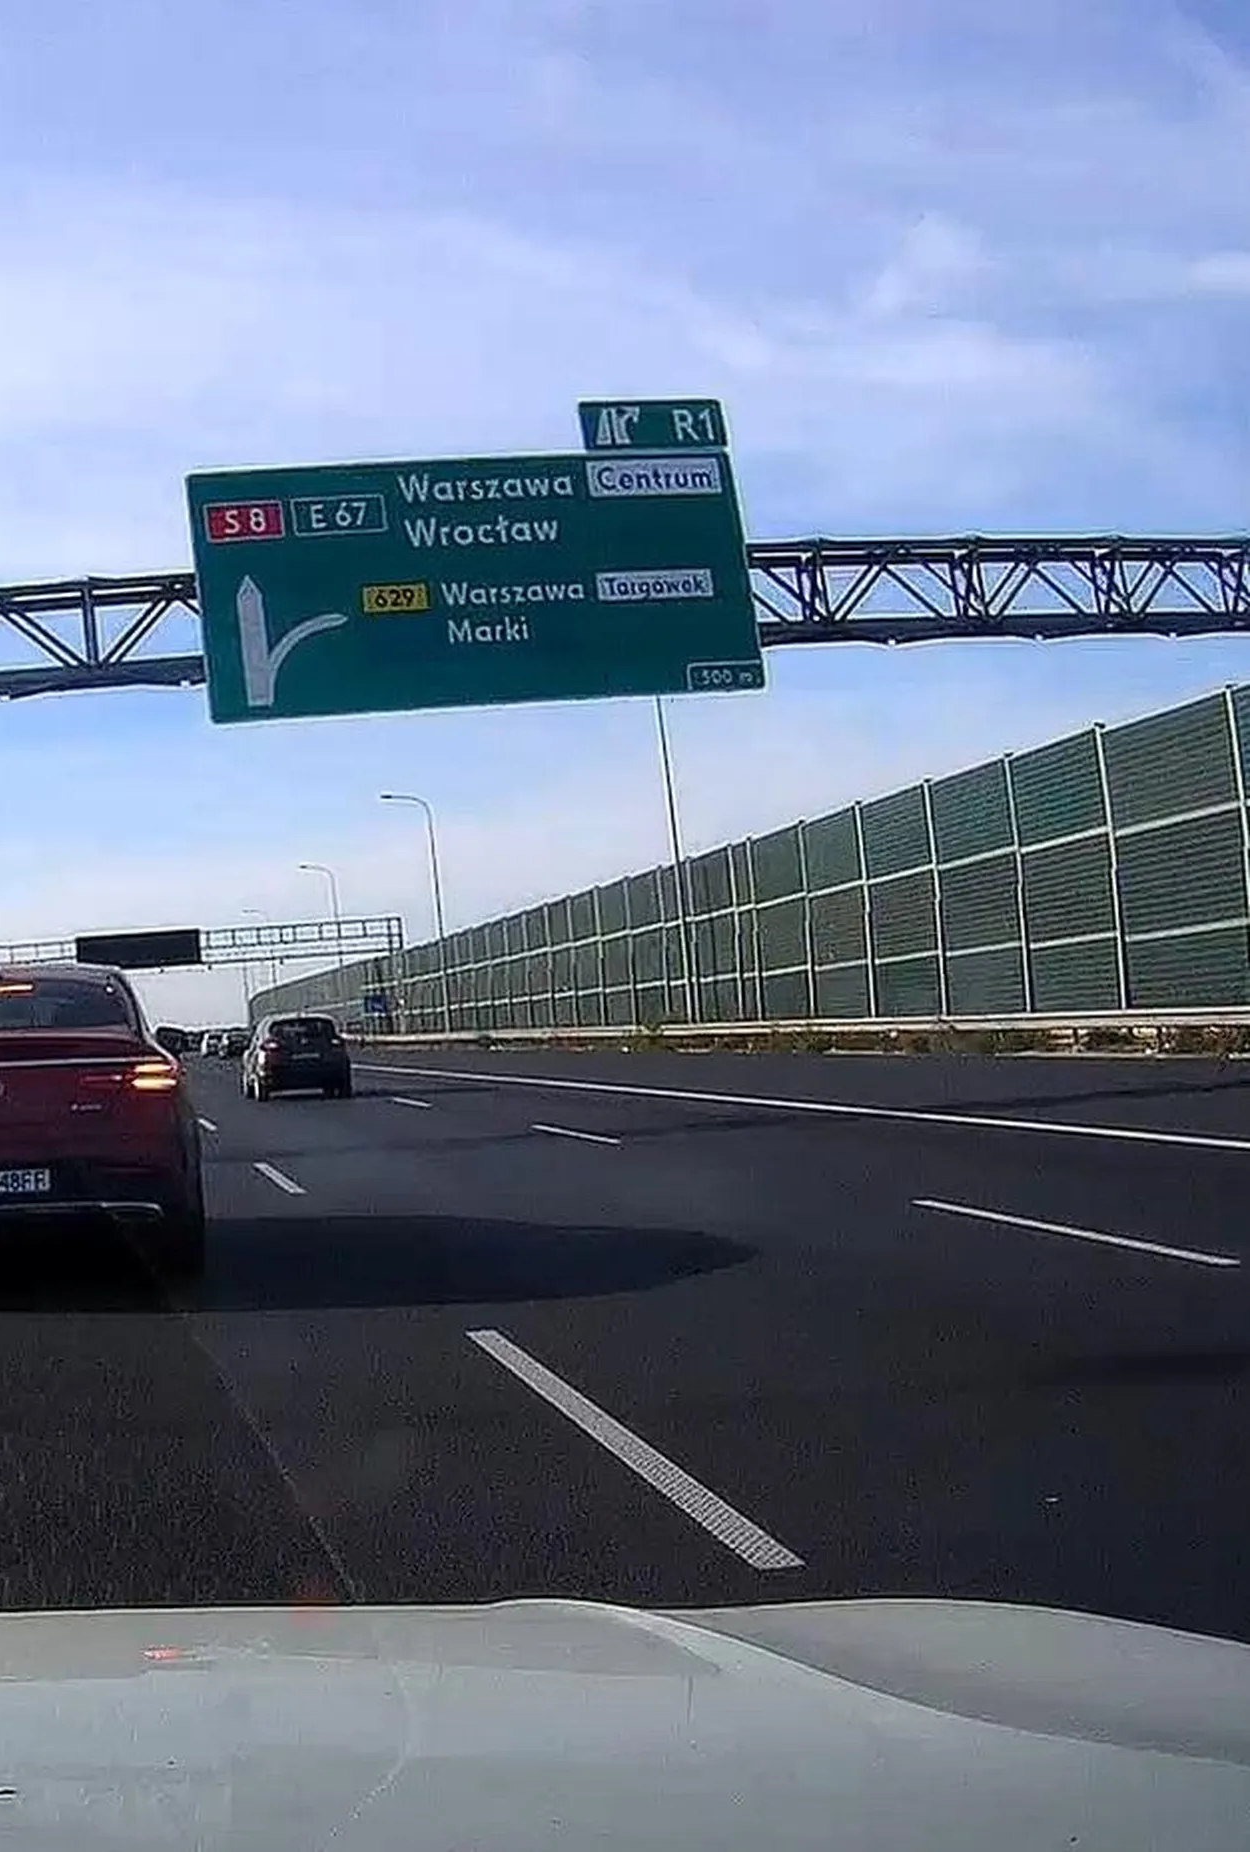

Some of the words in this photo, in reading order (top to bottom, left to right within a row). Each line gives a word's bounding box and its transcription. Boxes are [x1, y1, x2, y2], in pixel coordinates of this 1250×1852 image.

[672, 406, 715, 441] R1
[397, 473, 575, 503] Warszawa
[598, 466, 712, 490] Centrum
[404, 514, 559, 547] Wrocław
[374, 587, 415, 608] 629
[441, 581, 586, 605] Warszawa
[447, 616, 529, 643] Marki
